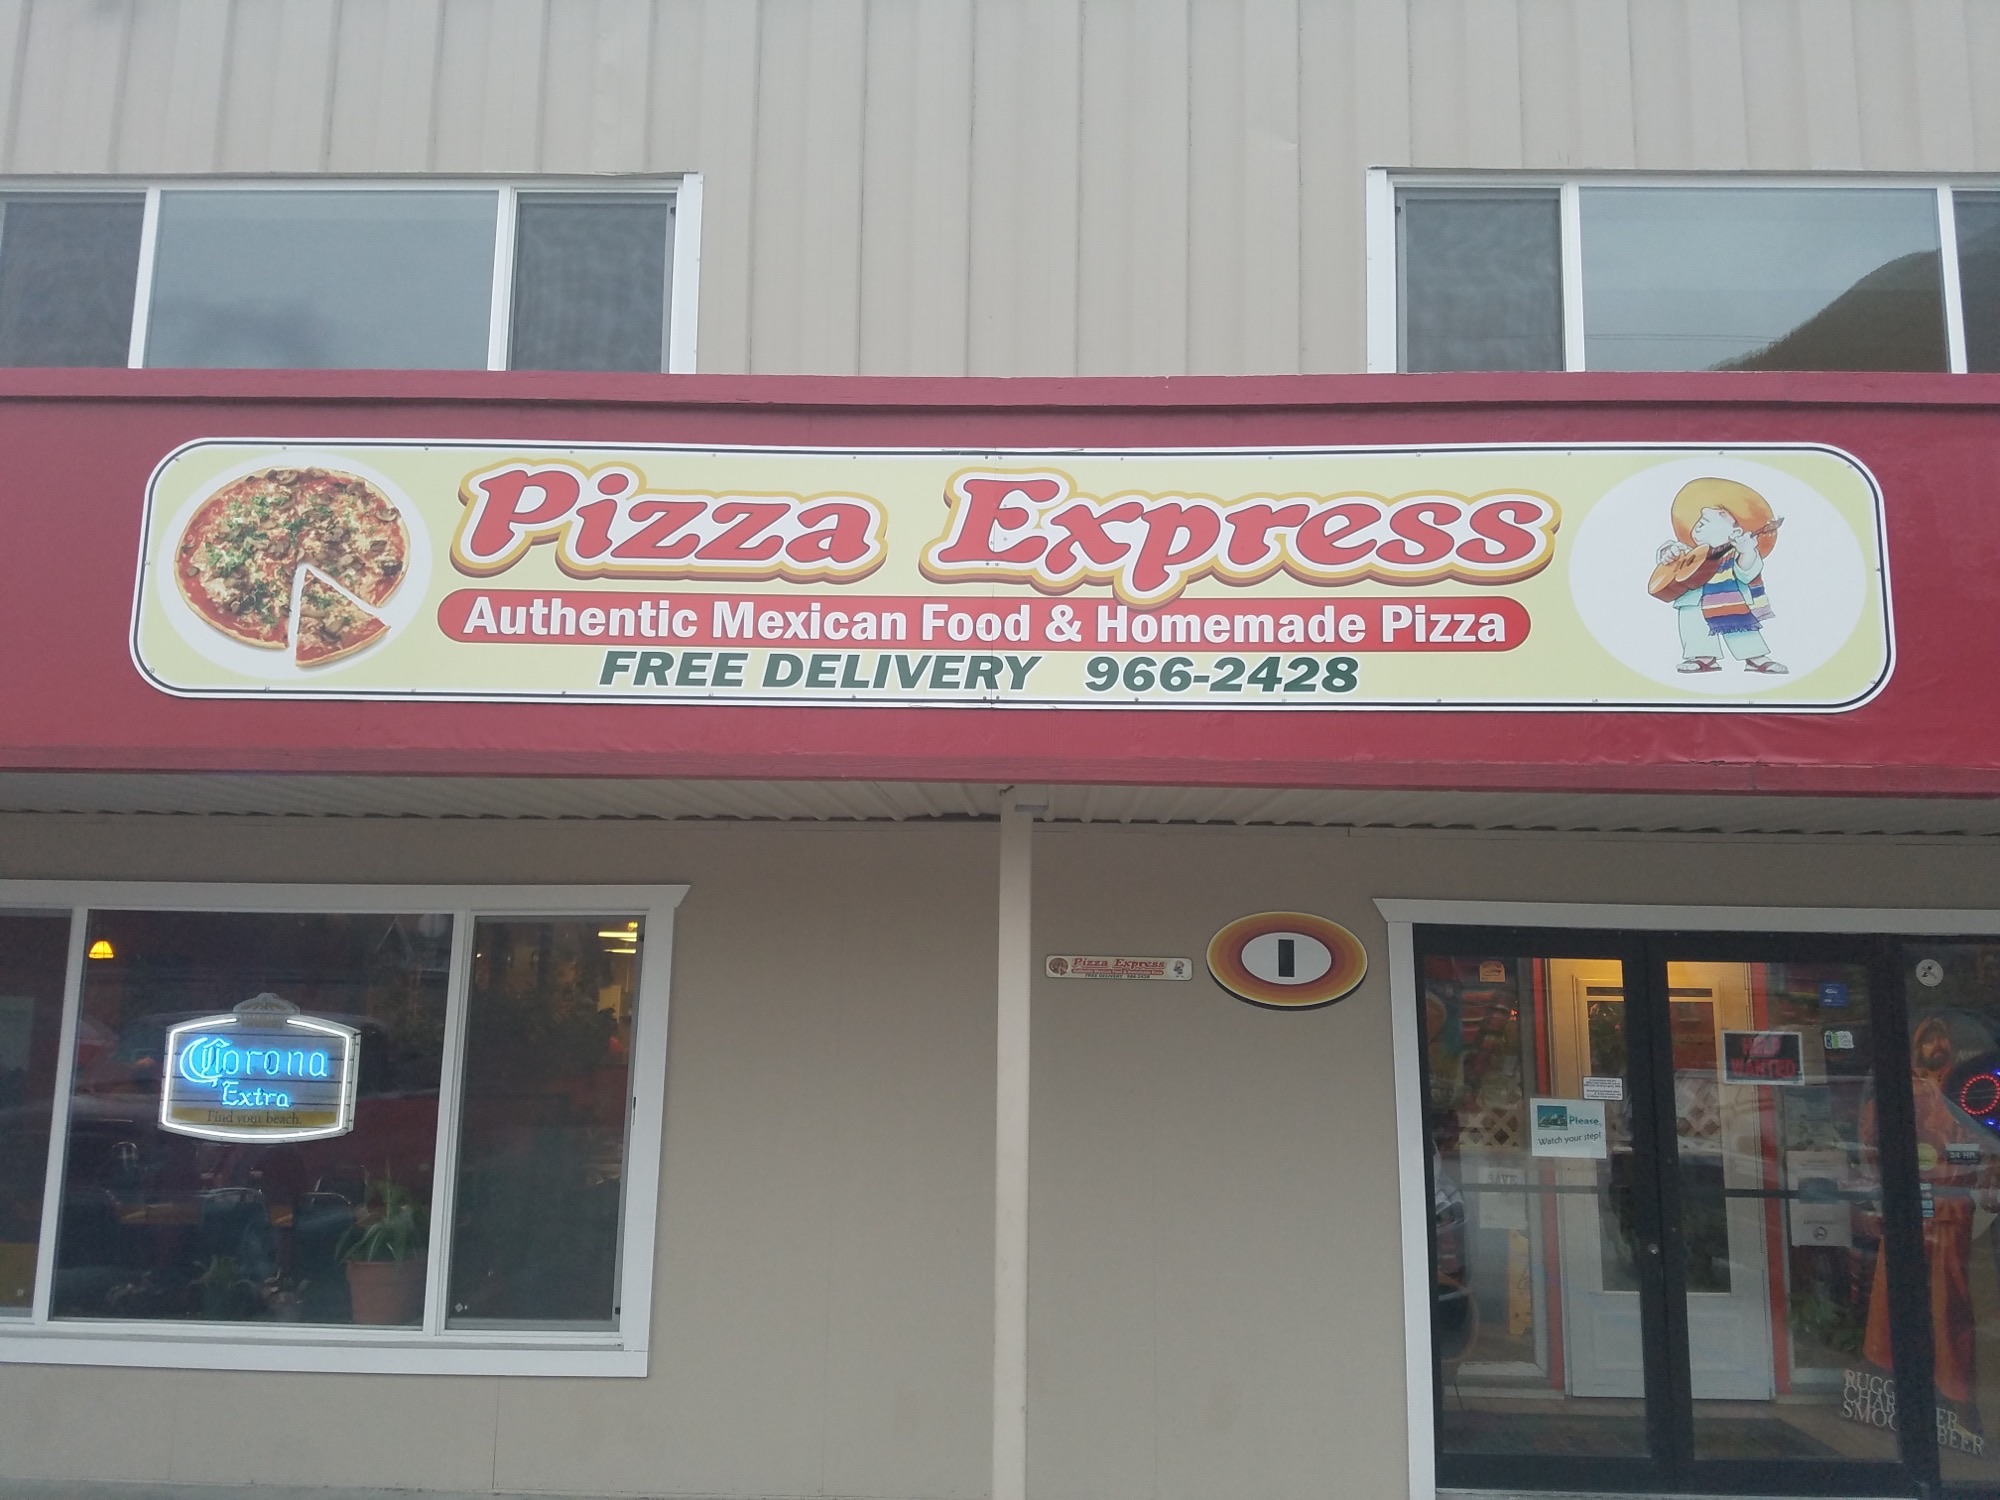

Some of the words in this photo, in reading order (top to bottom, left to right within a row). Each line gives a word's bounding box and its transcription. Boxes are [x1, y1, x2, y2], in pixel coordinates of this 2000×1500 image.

[462, 463, 880, 571] Pizza
[929, 473, 1550, 600] Express
[463, 596, 698, 638] Authentic
[712, 600, 907, 641] Mexican
[922, 603, 1031, 643] Food
[1046, 605, 1082, 643] &
[1097, 604, 1367, 644] Homemade
[1382, 605, 1507, 643] Pizza
[599, 650, 749, 687] FREE
[762, 652, 1041, 690] DELIVERY
[1085, 656, 1359, 693] 966-2428
[1073, 957, 1108, 968] Pizza
[1114, 958, 1166, 970] Express
[179, 1037, 328, 1087] Corona
[222, 1081, 290, 1107] Extra
[207, 1110, 233, 1123] Find
[1537, 1136, 1563, 1146] Watch
[1564, 1135, 1582, 1144] your
